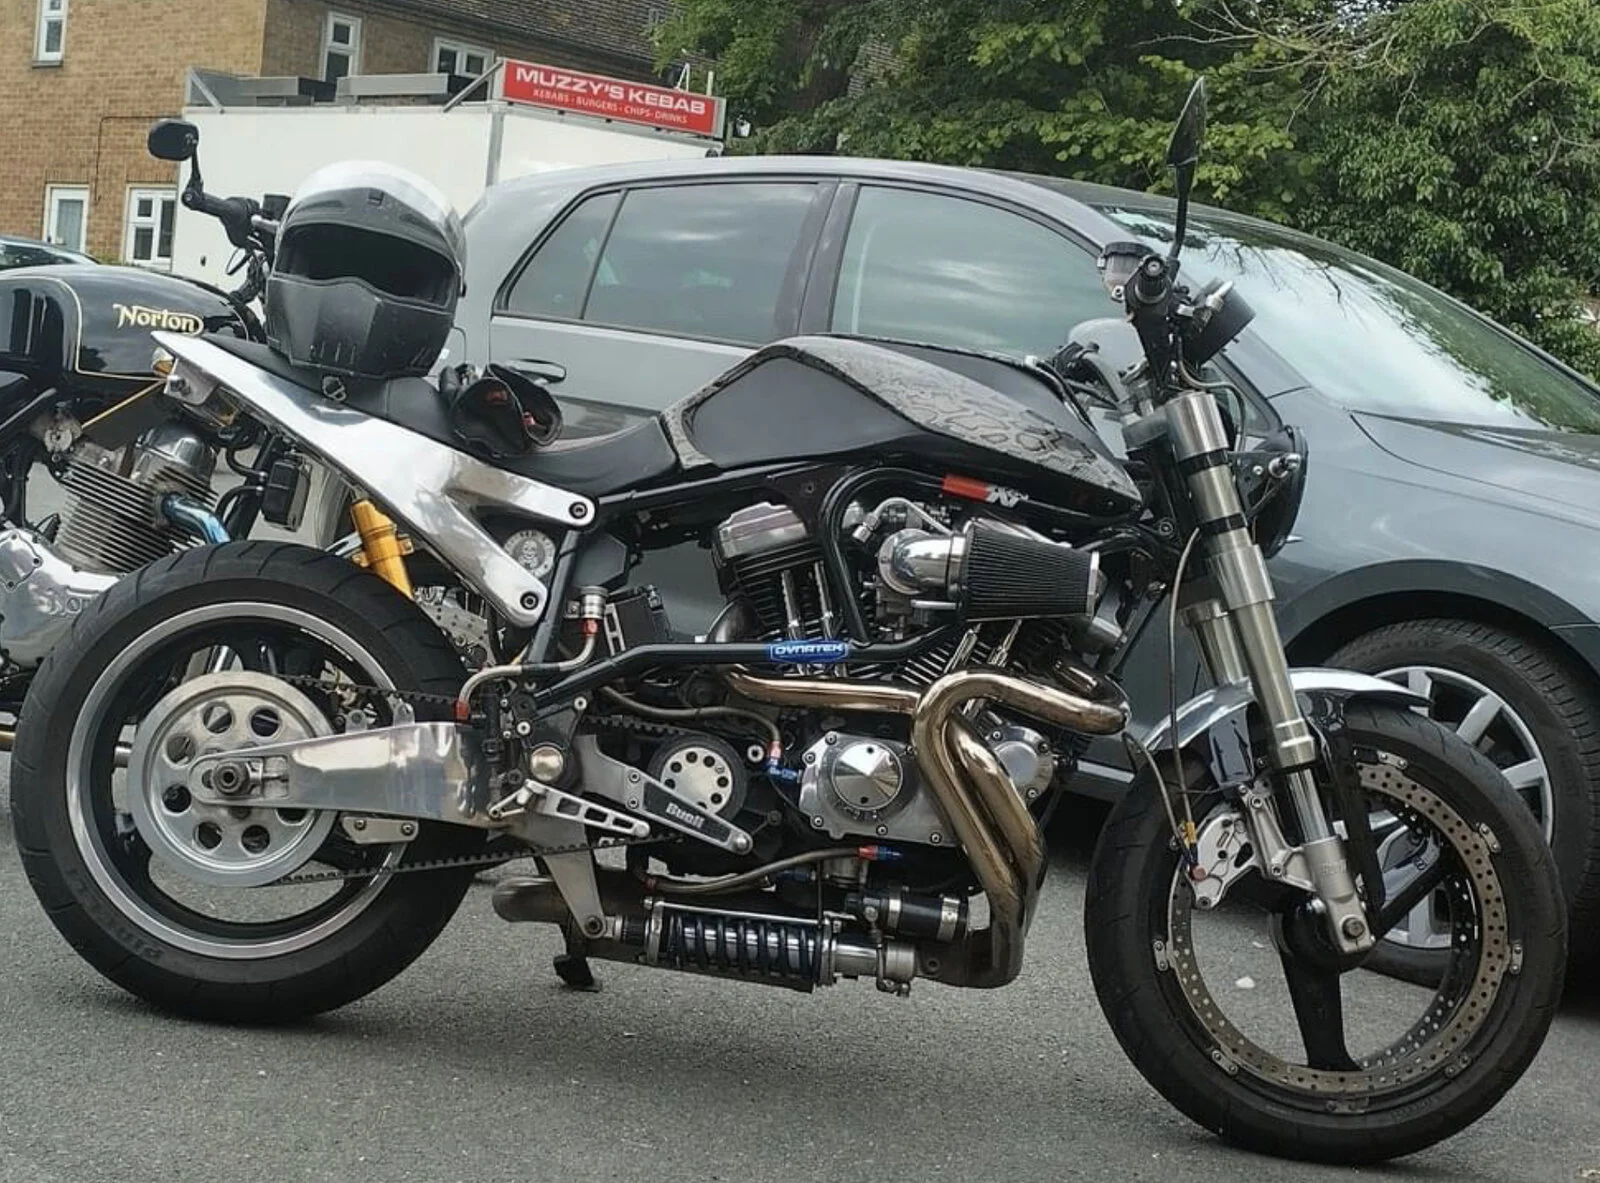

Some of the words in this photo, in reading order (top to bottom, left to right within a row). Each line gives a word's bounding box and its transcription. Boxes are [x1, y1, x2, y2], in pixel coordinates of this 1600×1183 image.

[516, 66, 625, 100] MUZZY'S
[628, 88, 706, 115] KEBAB
[576, 96, 618, 112] BURGERS
[623, 104, 650, 117] CHIPS
[654, 111, 688, 124] DRINKS
[112, 303, 204, 337] Norton
[775, 643, 843, 655] DYNATEK
